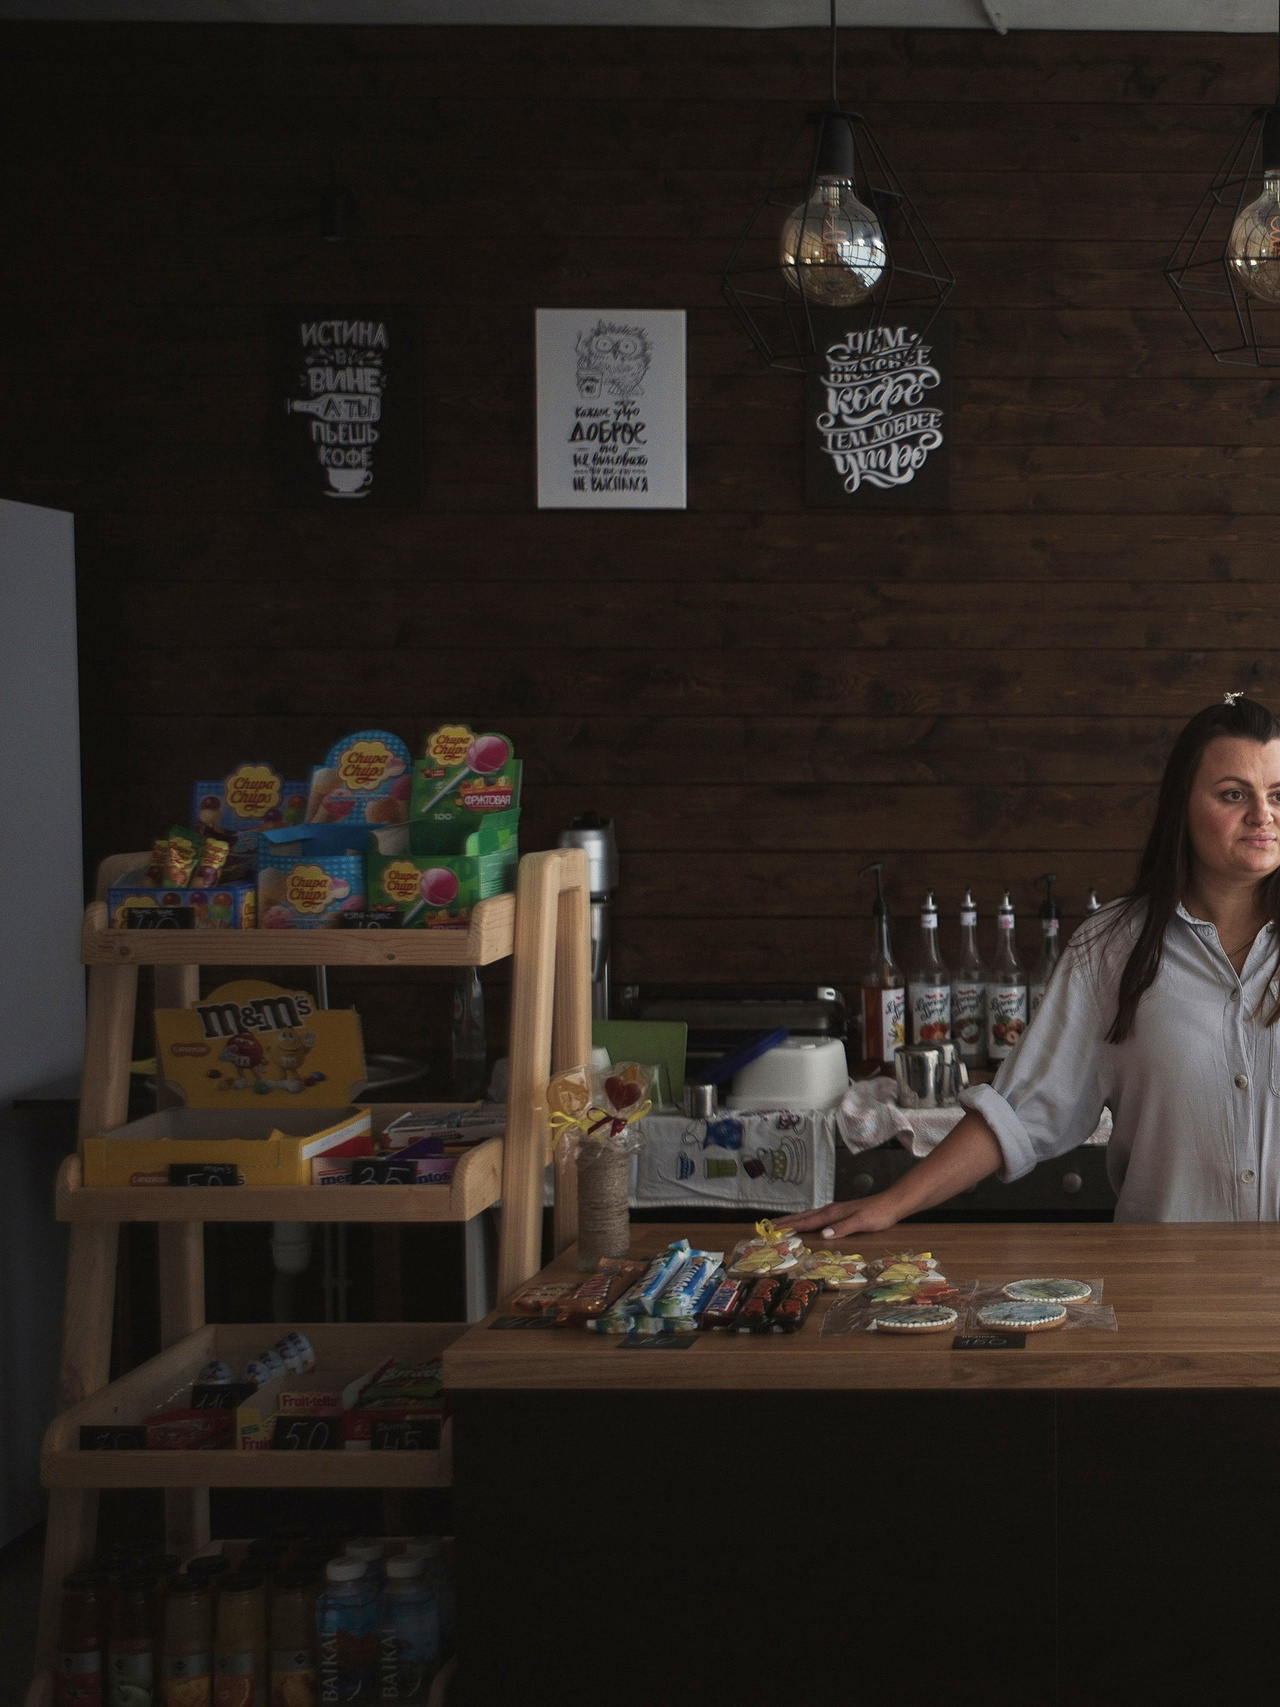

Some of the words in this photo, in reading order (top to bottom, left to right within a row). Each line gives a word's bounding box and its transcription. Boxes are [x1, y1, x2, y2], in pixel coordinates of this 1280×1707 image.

[301, 320, 389, 348] ИСТИНА
[336, 348, 347, 364] В
[308, 367, 383, 394] ВИНЕ
[826, 430, 869, 450] ТЕМ
[872, 412, 942, 443] ДОБРЕЕ
[319, 446, 374, 468] КОФЕ
[436, 735, 470, 747] Chupa
[433, 745, 467, 757] Chups
[347, 752, 389, 767] Chupa
[343, 765, 386, 779] Chups
[233, 777, 275, 792] Chupa
[230, 790, 273, 805] Chups
[464, 794, 511, 805] ФРУКТОВАЯ
[291, 876, 329, 889] Chupa
[388, 870, 419, 882] Chupa
[386, 880, 418, 893] Chups
[289, 888, 327, 902] Chups
[286, 1421, 330, 1450] 50
